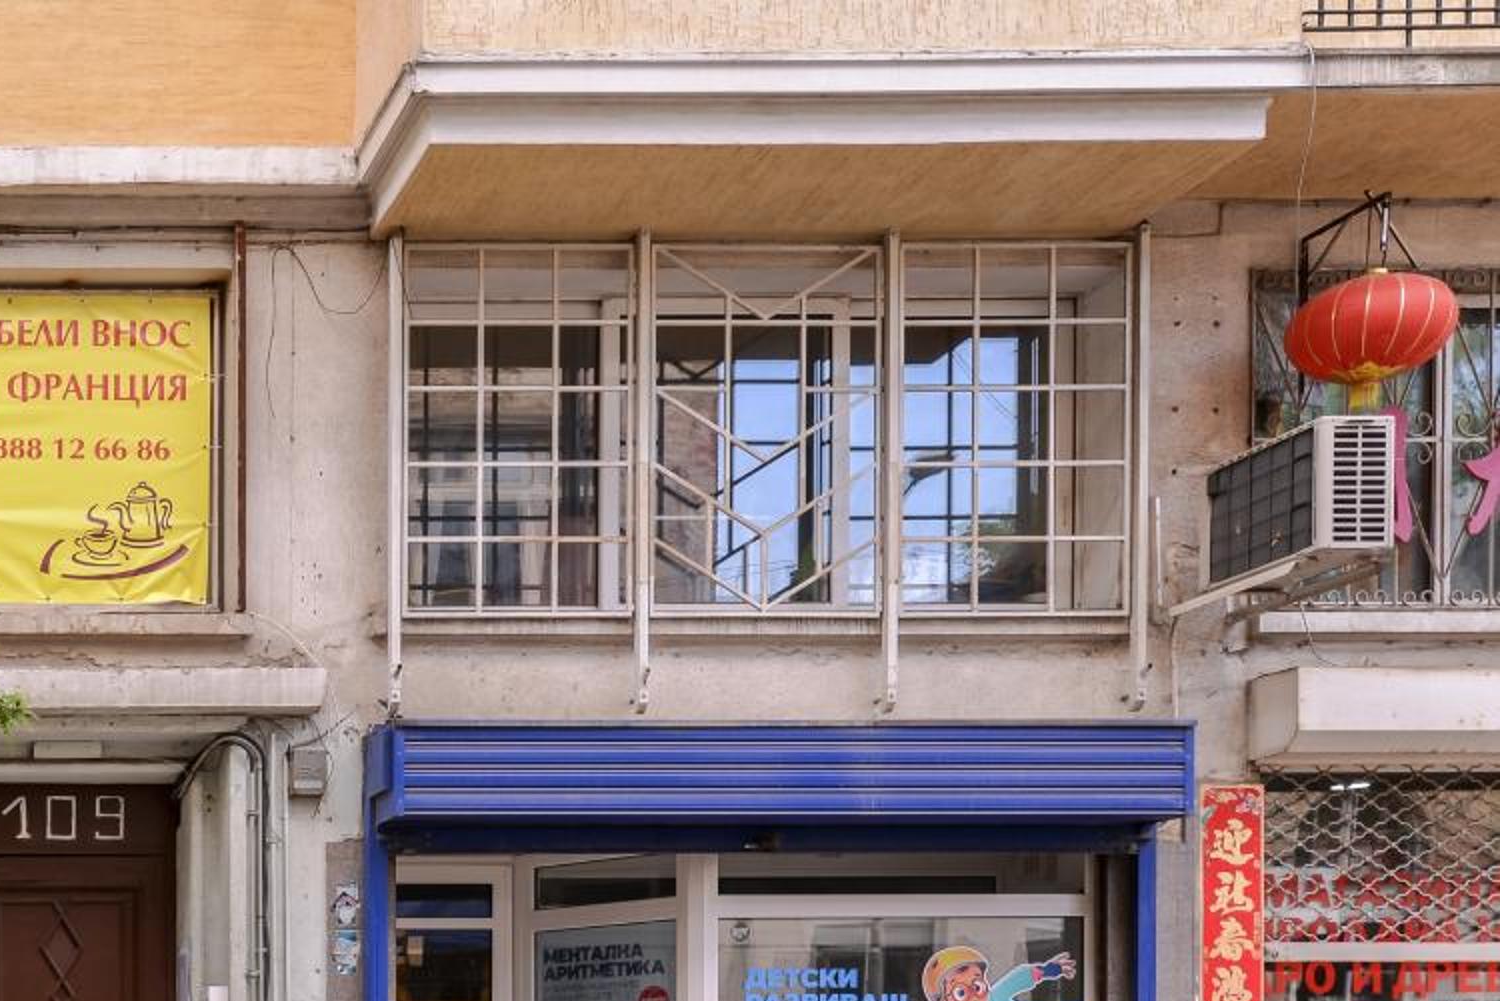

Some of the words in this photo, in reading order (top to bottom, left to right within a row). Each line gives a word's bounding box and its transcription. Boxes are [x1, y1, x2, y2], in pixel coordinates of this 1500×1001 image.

[91, 320, 191, 348] ВНОС
[7, 371, 188, 409] ФРАНЦИЯ
[54, 438, 85, 461] 12
[94, 438, 127, 461] 66
[137, 438, 171, 461] 86
[2, 795, 125, 841] 109
[543, 943, 644, 964] МЕНТАЛНА
[544, 960, 665, 981] АРИТМЕТИКА
[744, 967, 860, 990] ДЕТСКИ
